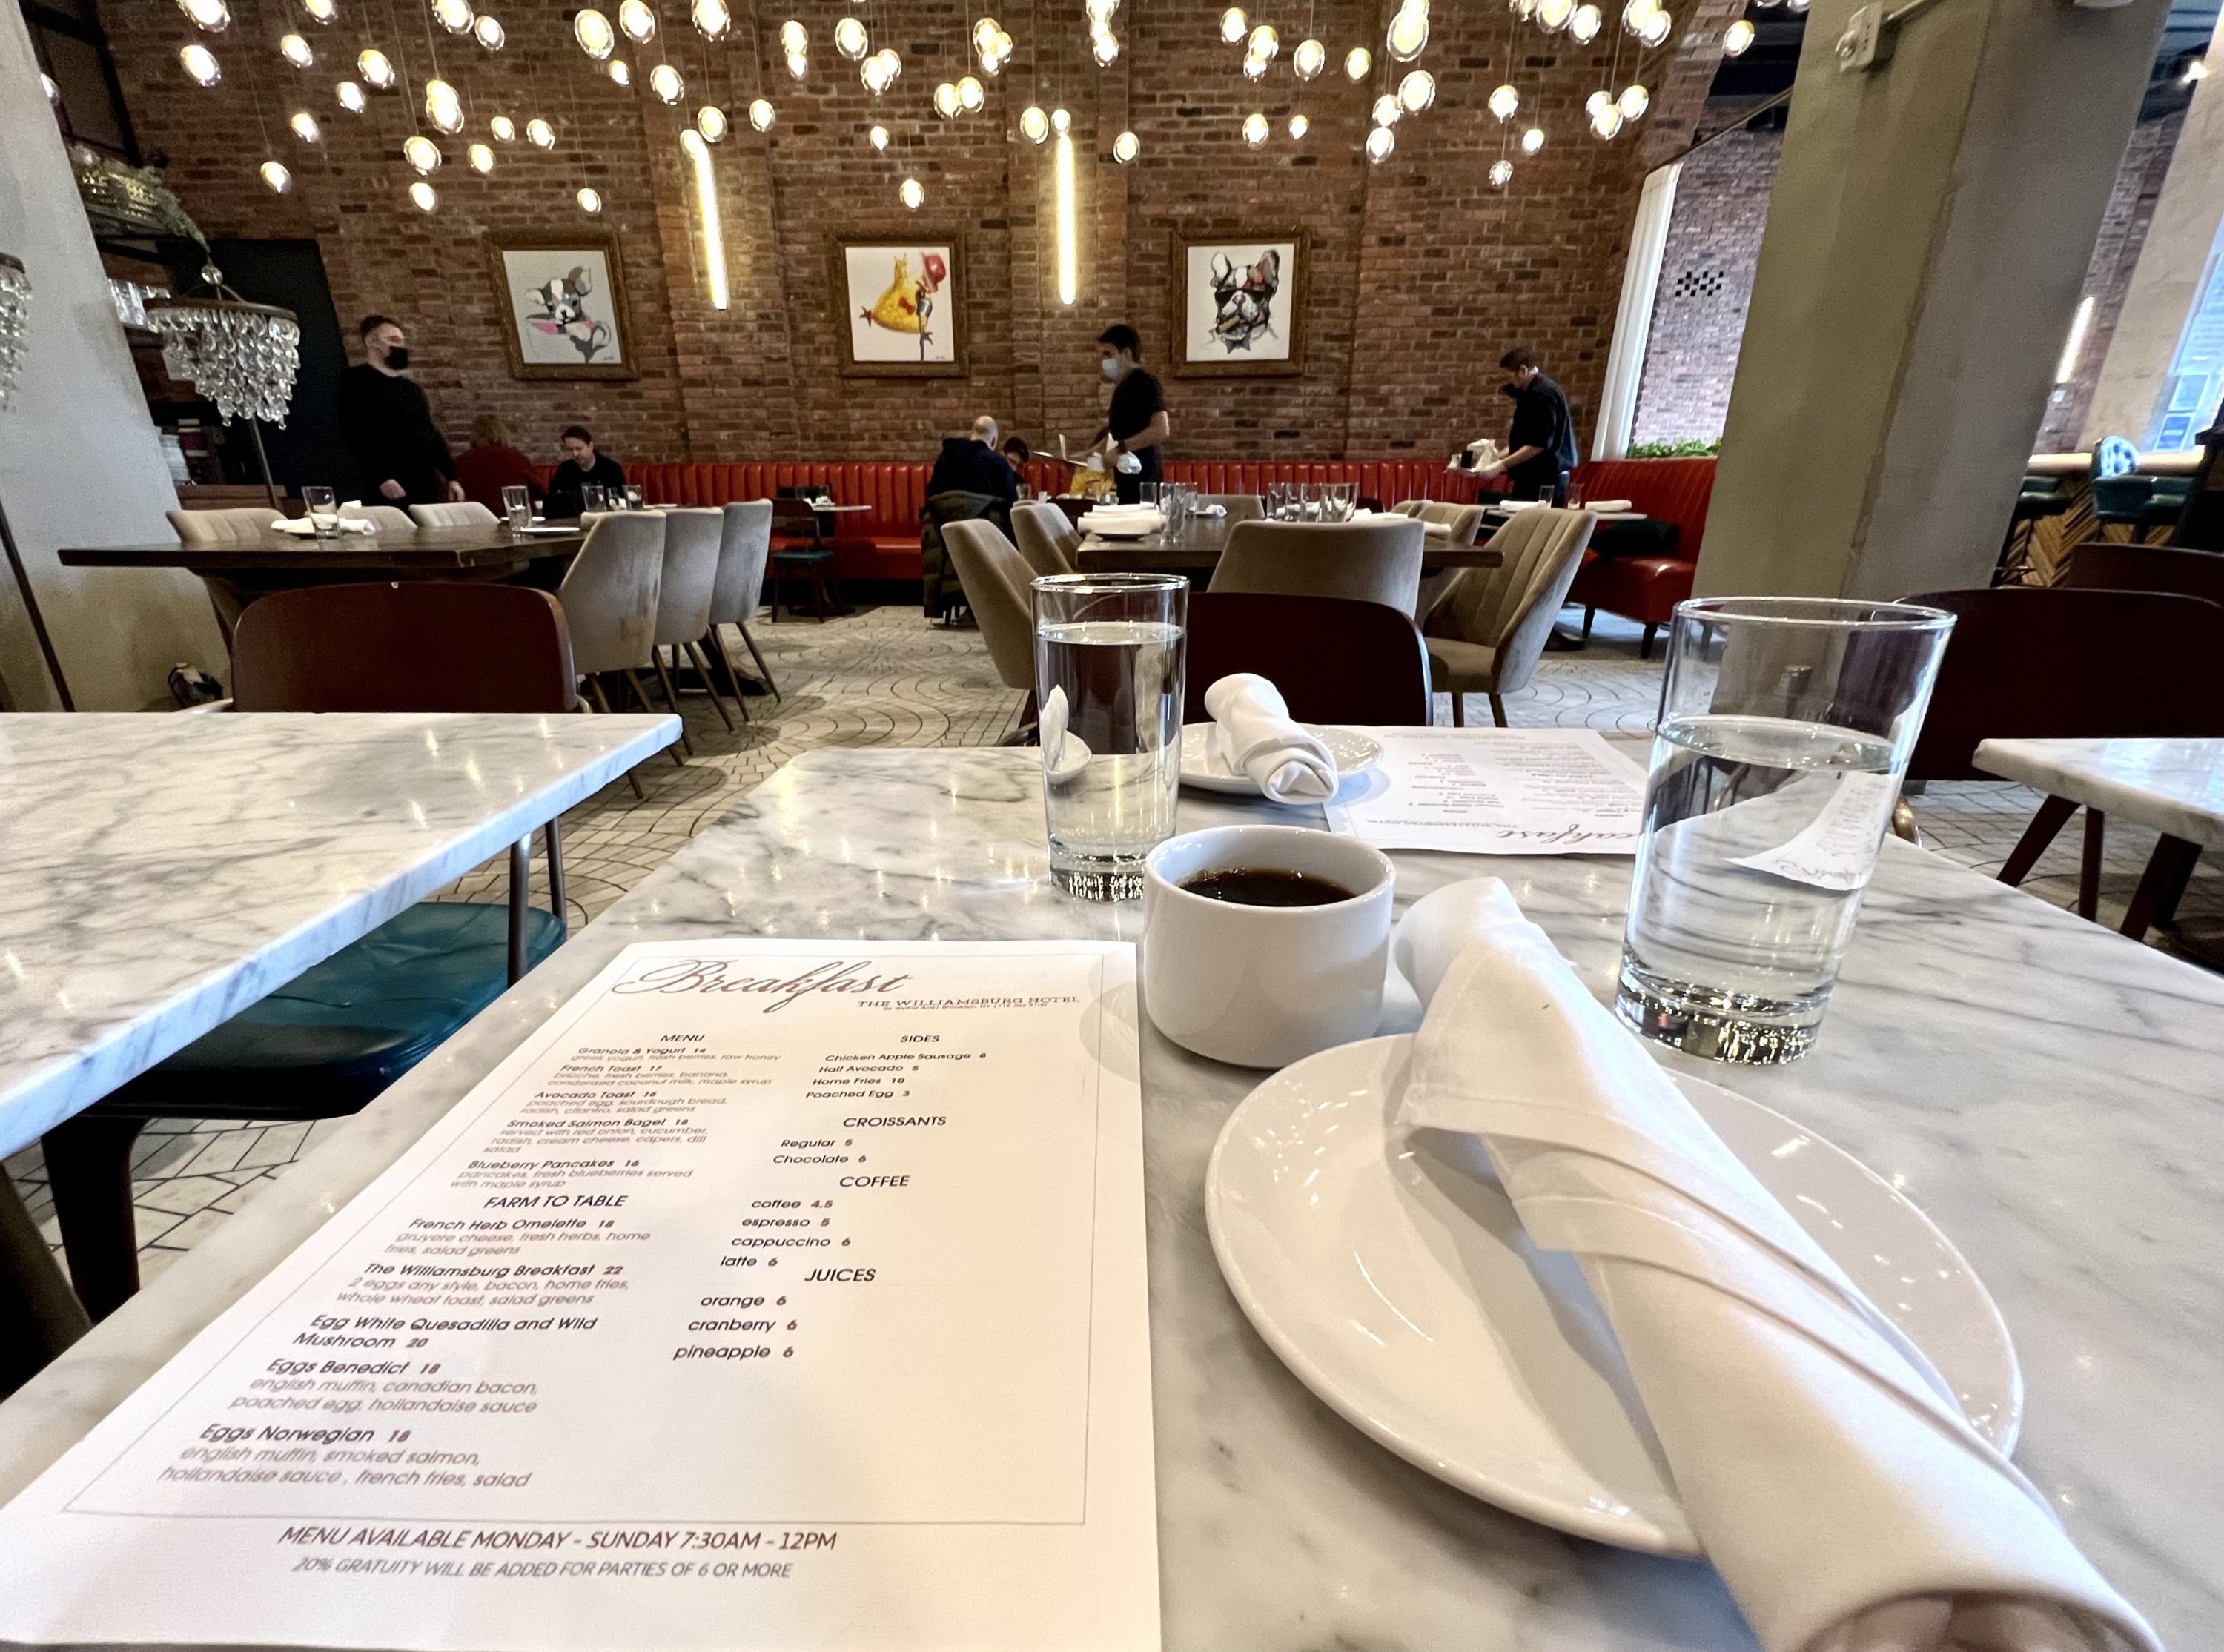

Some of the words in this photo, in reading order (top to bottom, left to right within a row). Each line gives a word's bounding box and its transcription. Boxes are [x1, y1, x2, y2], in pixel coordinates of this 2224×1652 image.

[612, 960, 913, 1013] Breakfast
[896, 998, 1022, 1006] WILLIAMSBURG
[869, 1090, 894, 1098] Egg
[623, 1118, 666, 1127] Bagel
[843, 1116, 947, 1127] CROISSANTS
[781, 1139, 836, 1149] Regular
[468, 1160, 540, 1170] Blueberry
[541, 1160, 615, 1169] Pancakes
[772, 1155, 849, 1164] Chocolate
[858, 1155, 867, 1163] 6
[533, 1170, 565, 1178] fresh
[569, 1169, 643, 1178] blueberries
[646, 1170, 694, 1178] served
[450, 1180, 477, 1188] with
[480, 1180, 526, 1188] maple
[839, 1175, 910, 1187] COFFEE
[483, 1197, 541, 1208] FARM
[543, 1196, 569, 1207] TO
[572, 1195, 629, 1207] TABLE
[752, 1199, 801, 1208] coffee
[810, 1199, 833, 1208] 4.5
[408, 1219, 466, 1230] French
[469, 1220, 508, 1230] Herb
[512, 1219, 586, 1229] Omelette
[598, 1220, 615, 1228] 18
[741, 1218, 810, 1228] espresso
[820, 1218, 830, 1227] 5
[395, 1233, 455, 1243] gruyere
[519, 1232, 556, 1241] fresh
[606, 1232, 651, 1241] home
[731, 1237, 831, 1248] cappuccino
[841, 1238, 850, 1247] 6
[422, 1246, 467, 1255] salad
[467, 1247, 521, 1256] greens
[720, 1256, 758, 1267] latte
[767, 1257, 778, 1267] 6
[365, 1263, 396, 1275] The
[400, 1264, 511, 1278] Williamsburg
[514, 1264, 595, 1276] Breakfast
[603, 1266, 624, 1275] 22
[804, 1269, 876, 1282] JUICES
[348, 1277, 363, 1287] 2
[363, 1278, 405, 1290] eggs
[408, 1280, 442, 1291] any
[544, 1279, 592, 1290] home
[337, 1291, 386, 1304] whole
[390, 1293, 441, 1304] wheat
[489, 1294, 536, 1305] salad
[538, 1295, 595, 1307] greens
[701, 1296, 765, 1309] orange
[776, 1296, 787, 1306] 6
[310, 1315, 351, 1330] Egg
[354, 1317, 406, 1329] White
[410, 1318, 511, 1331] Quesadilla
[514, 1318, 554, 1331] and
[557, 1318, 598, 1330] Wild
[688, 1318, 776, 1333] cranberry
[787, 1319, 798, 1331] 6
[292, 1333, 396, 1348] Mushroom
[406, 1338, 429, 1348] 20
[672, 1344, 770, 1361] pineapple
[783, 1346, 794, 1358] 6
[265, 1359, 316, 1376] Eggs
[320, 1361, 410, 1374] Benedict
[420, 1363, 441, 1374] 18
[250, 1378, 316, 1393] english
[383, 1379, 473, 1393] canadian
[228, 1395, 320, 1410] poached
[370, 1398, 477, 1412] hollandaise
[480, 1401, 537, 1413] sauce
[199, 1423, 255, 1442] Eggs
[258, 1426, 375, 1444] Norwegian
[388, 1430, 411, 1443] 18
[179, 1445, 253, 1462] english
[323, 1448, 404, 1463] smoked
[157, 1465, 278, 1483] hollandaise
[279, 1470, 343, 1483] sauce
[355, 1469, 429, 1485] french
[473, 1472, 532, 1488] salad
[277, 1526, 351, 1545] MENU
[348, 1527, 472, 1548] AVAILABLE
[470, 1530, 572, 1549] MONDAY
[586, 1531, 678, 1549] SUNDAY
[679, 1531, 761, 1550] 7:30AM
[778, 1531, 838, 1550] 12PM
[291, 1557, 331, 1572] 20%
[334, 1558, 423, 1574] GRATUITY
[424, 1560, 465, 1576] WILL
[469, 1562, 494, 1577] BE
[494, 1562, 557, 1577] ADDED
[559, 1562, 596, 1576] FOR
[598, 1562, 669, 1576] PARTIES
[671, 1563, 697, 1576] OF
[698, 1562, 709, 1576] 6
[713, 1563, 739, 1577] OR
[741, 1563, 795, 1578] MORE
